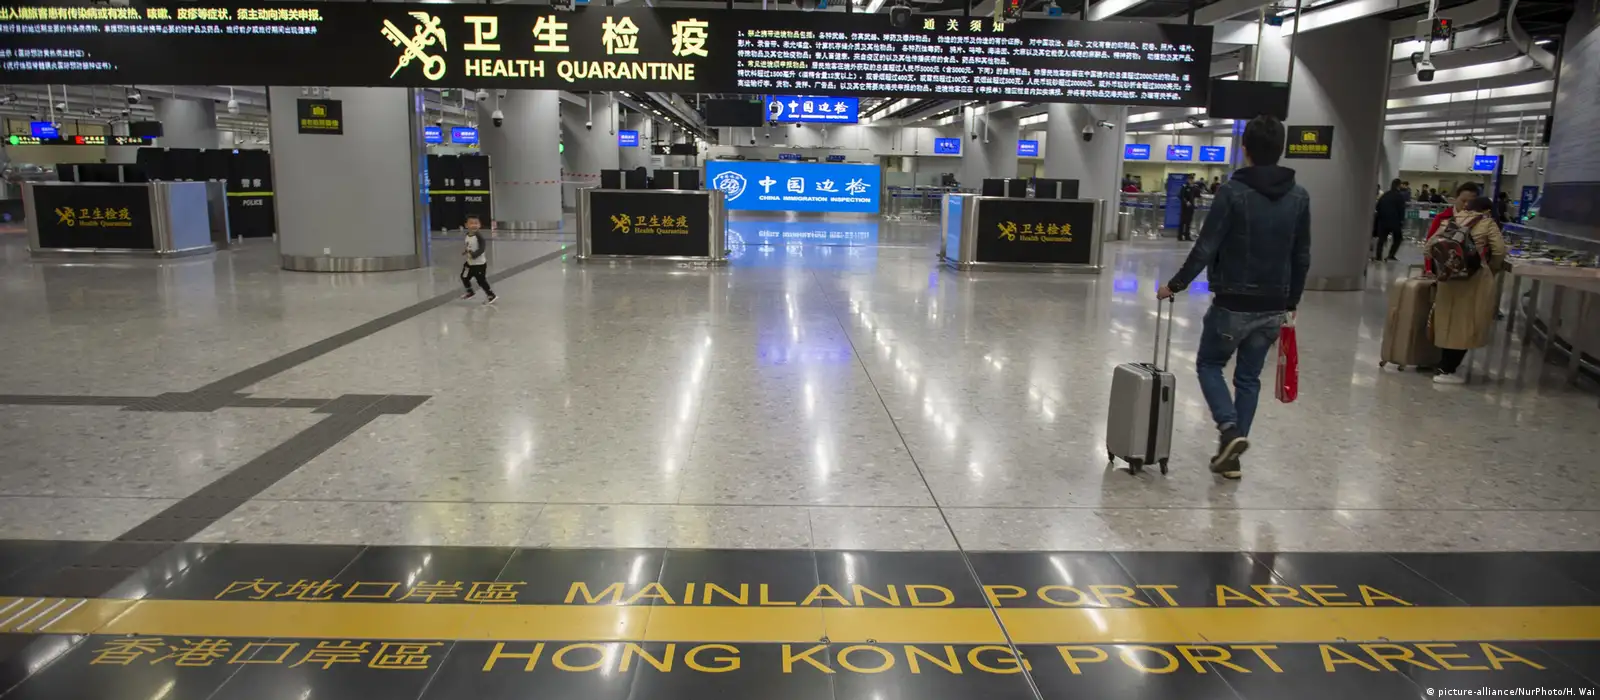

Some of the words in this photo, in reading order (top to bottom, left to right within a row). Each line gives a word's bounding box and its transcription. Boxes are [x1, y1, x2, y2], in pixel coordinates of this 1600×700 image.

[923, 18, 1005, 32] 通关须知
[463, 15, 709, 57] 卫生检疫
[465, 59, 545, 78] HEALTH
[557, 60, 695, 82] QUARANTINE
[788, 100, 848, 114] 中国边检
[758, 176, 871, 195] 中国边检
[78, 207, 132, 220] 卫生检疫
[634, 214, 689, 228] 卫生检疫
[1020, 223, 1073, 236] 卫生检疫
[563, 581, 955, 607] MAINLAND
[982, 584, 1182, 608] PORT
[1215, 584, 1414, 607] AREA
[90, 637, 445, 671] 香港口岸區
[482, 642, 741, 673] HONG
[781, 643, 1033, 675] KONG
[1056, 644, 1284, 675] PORT
[1318, 642, 1547, 673] AREA
